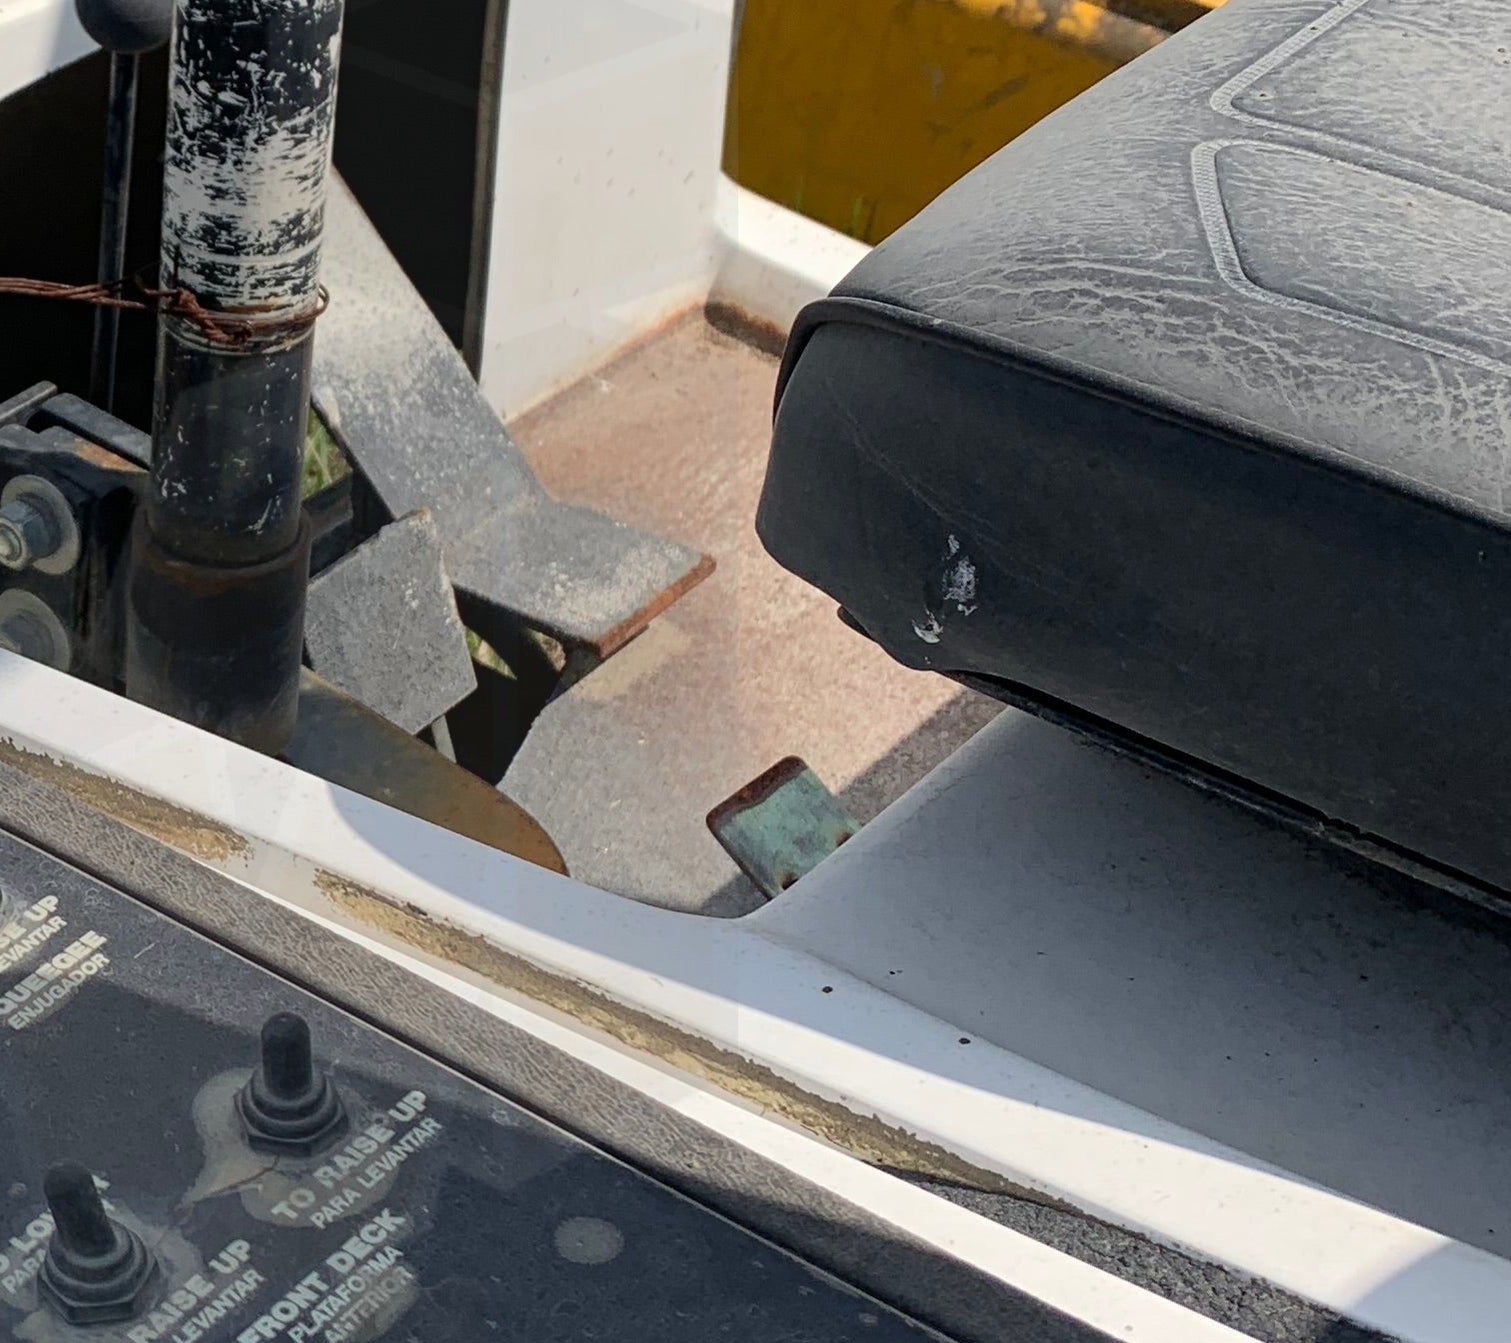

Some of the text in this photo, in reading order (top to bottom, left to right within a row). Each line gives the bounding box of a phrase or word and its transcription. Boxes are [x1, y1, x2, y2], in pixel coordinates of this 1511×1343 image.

[23, 894, 61, 922] UP
[7, 952, 111, 1031] ENJUGADOR
[271, 1089, 428, 1221] TO RAISE UP
[309, 1116, 444, 1230] PARA LEVANTAR
[208, 1238, 252, 1275] UP
[326, 1207, 408, 1275] DECK
